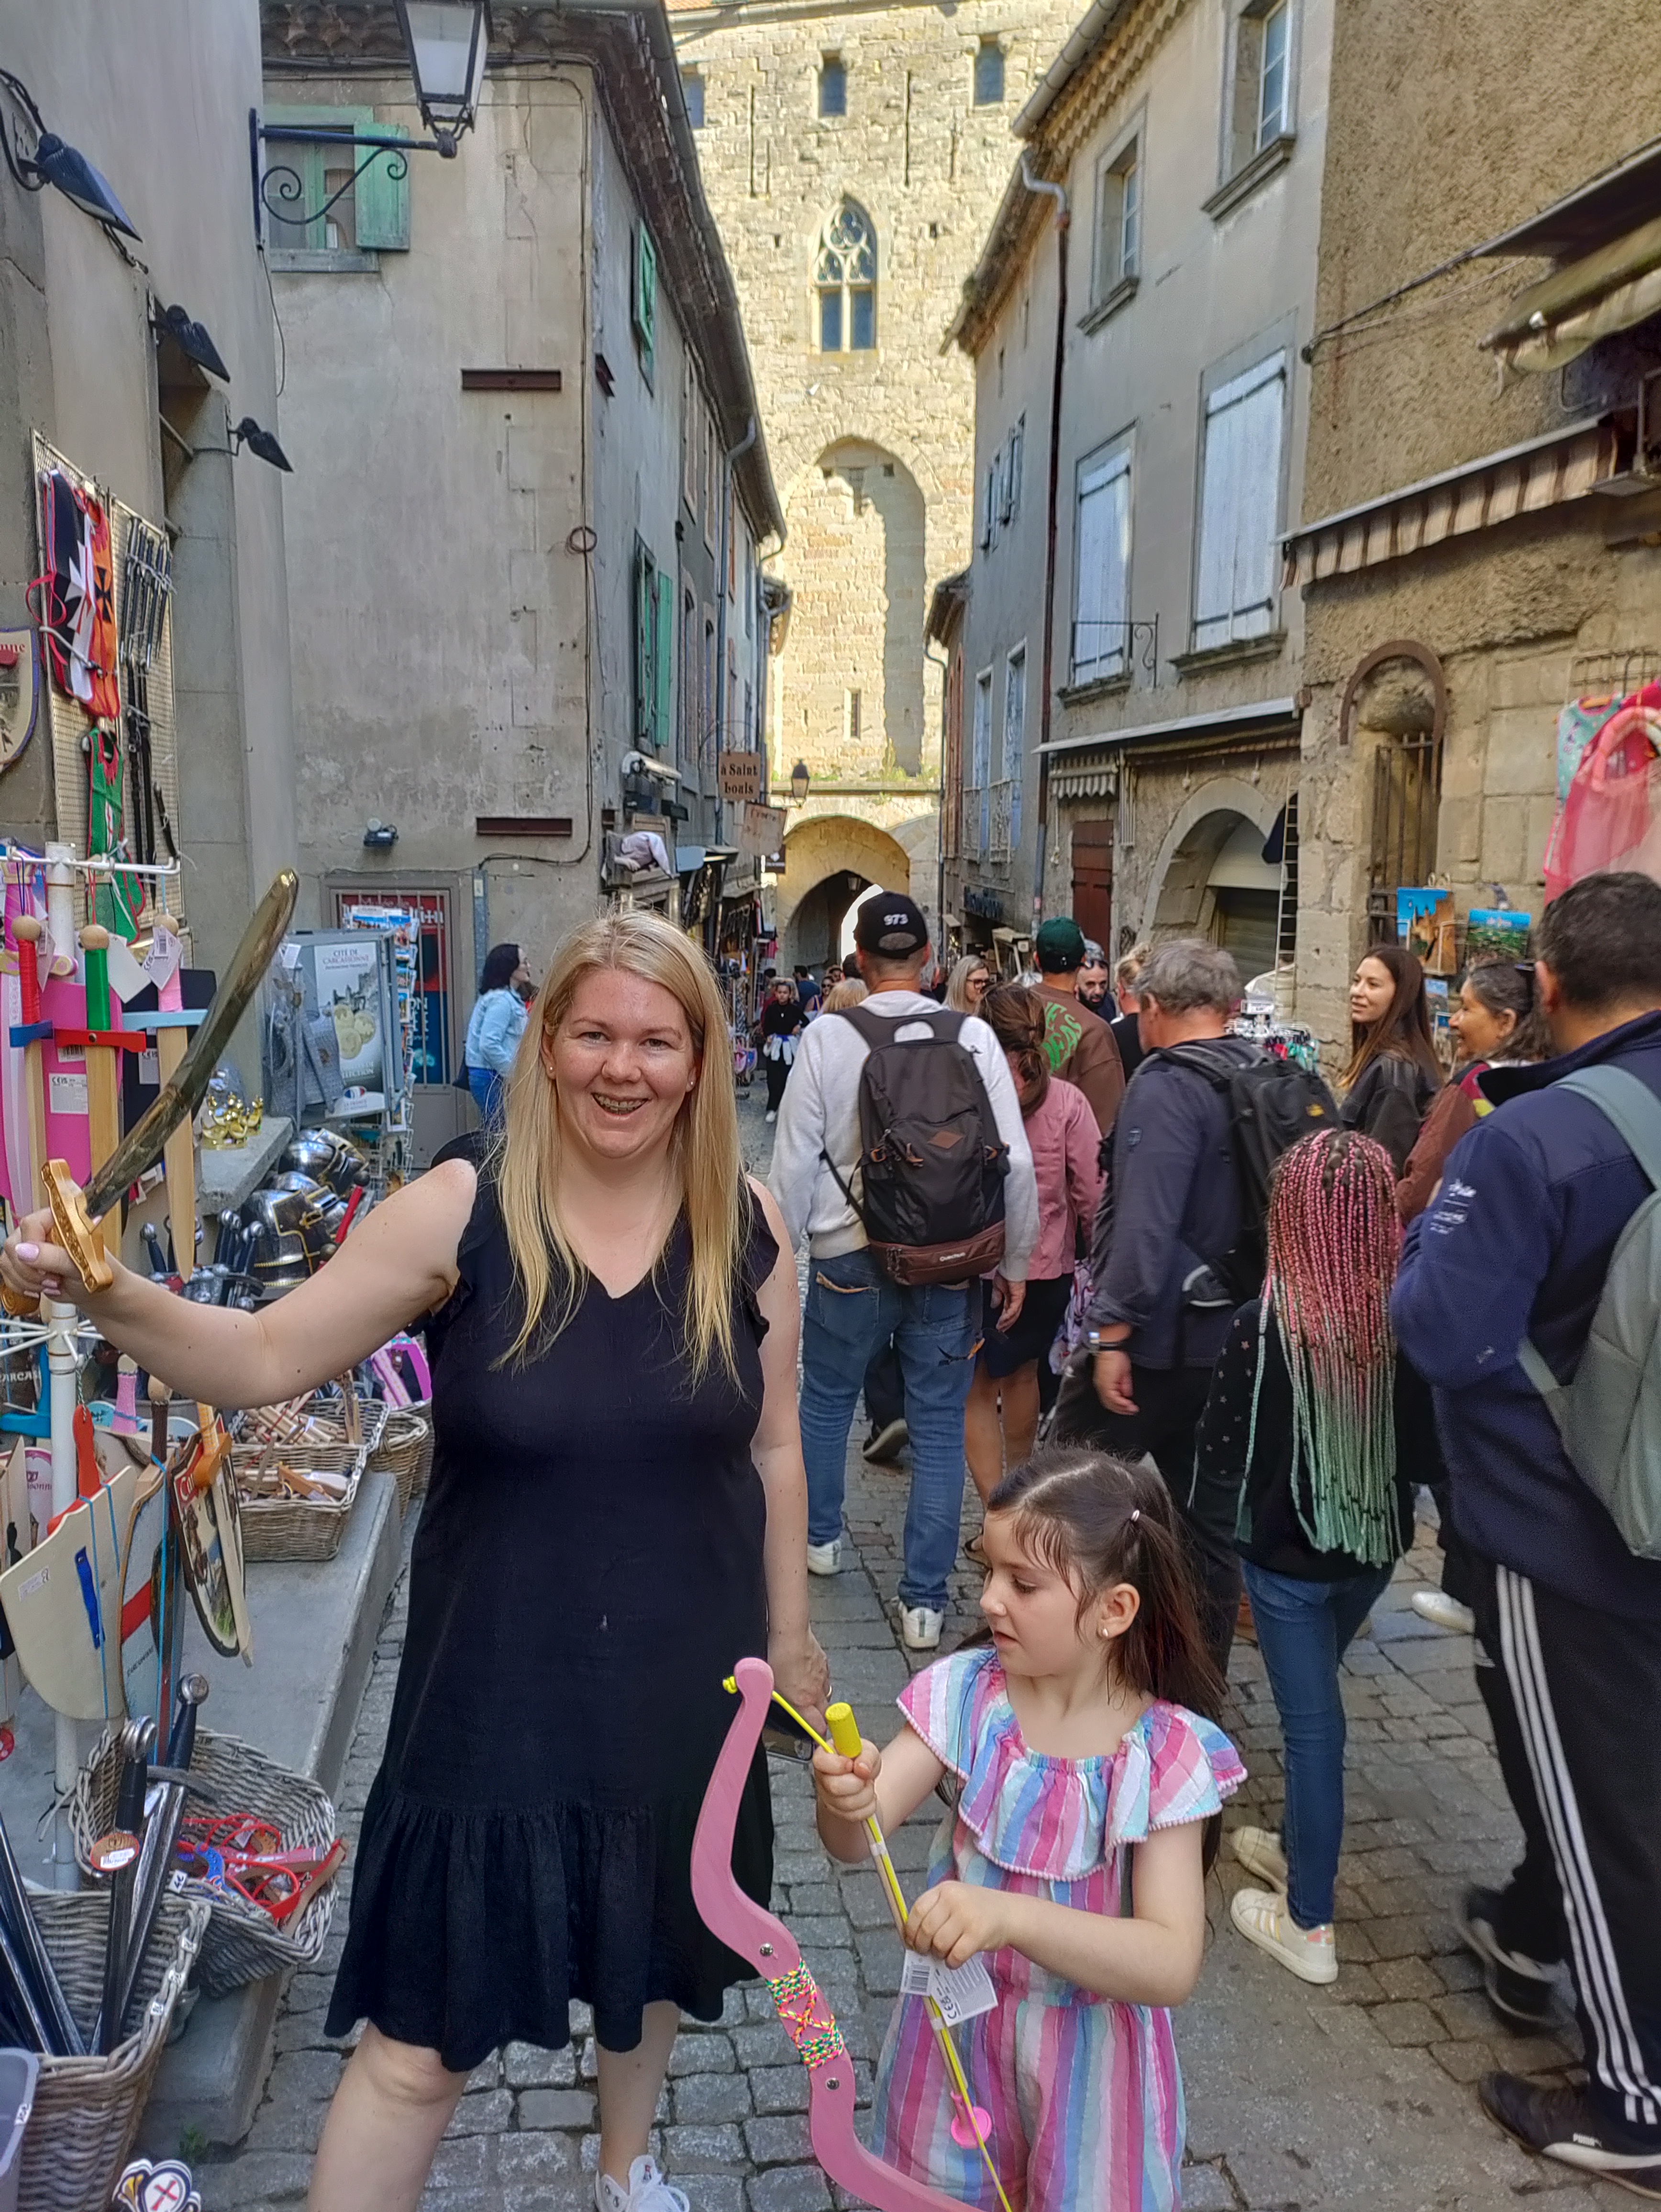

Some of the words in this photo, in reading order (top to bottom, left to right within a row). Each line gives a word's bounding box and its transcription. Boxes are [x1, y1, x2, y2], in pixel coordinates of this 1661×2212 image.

[729, 764, 758, 776] Saint
[724, 781, 753, 794] Louis
[1573, 2133, 1595, 2147] PUMA
